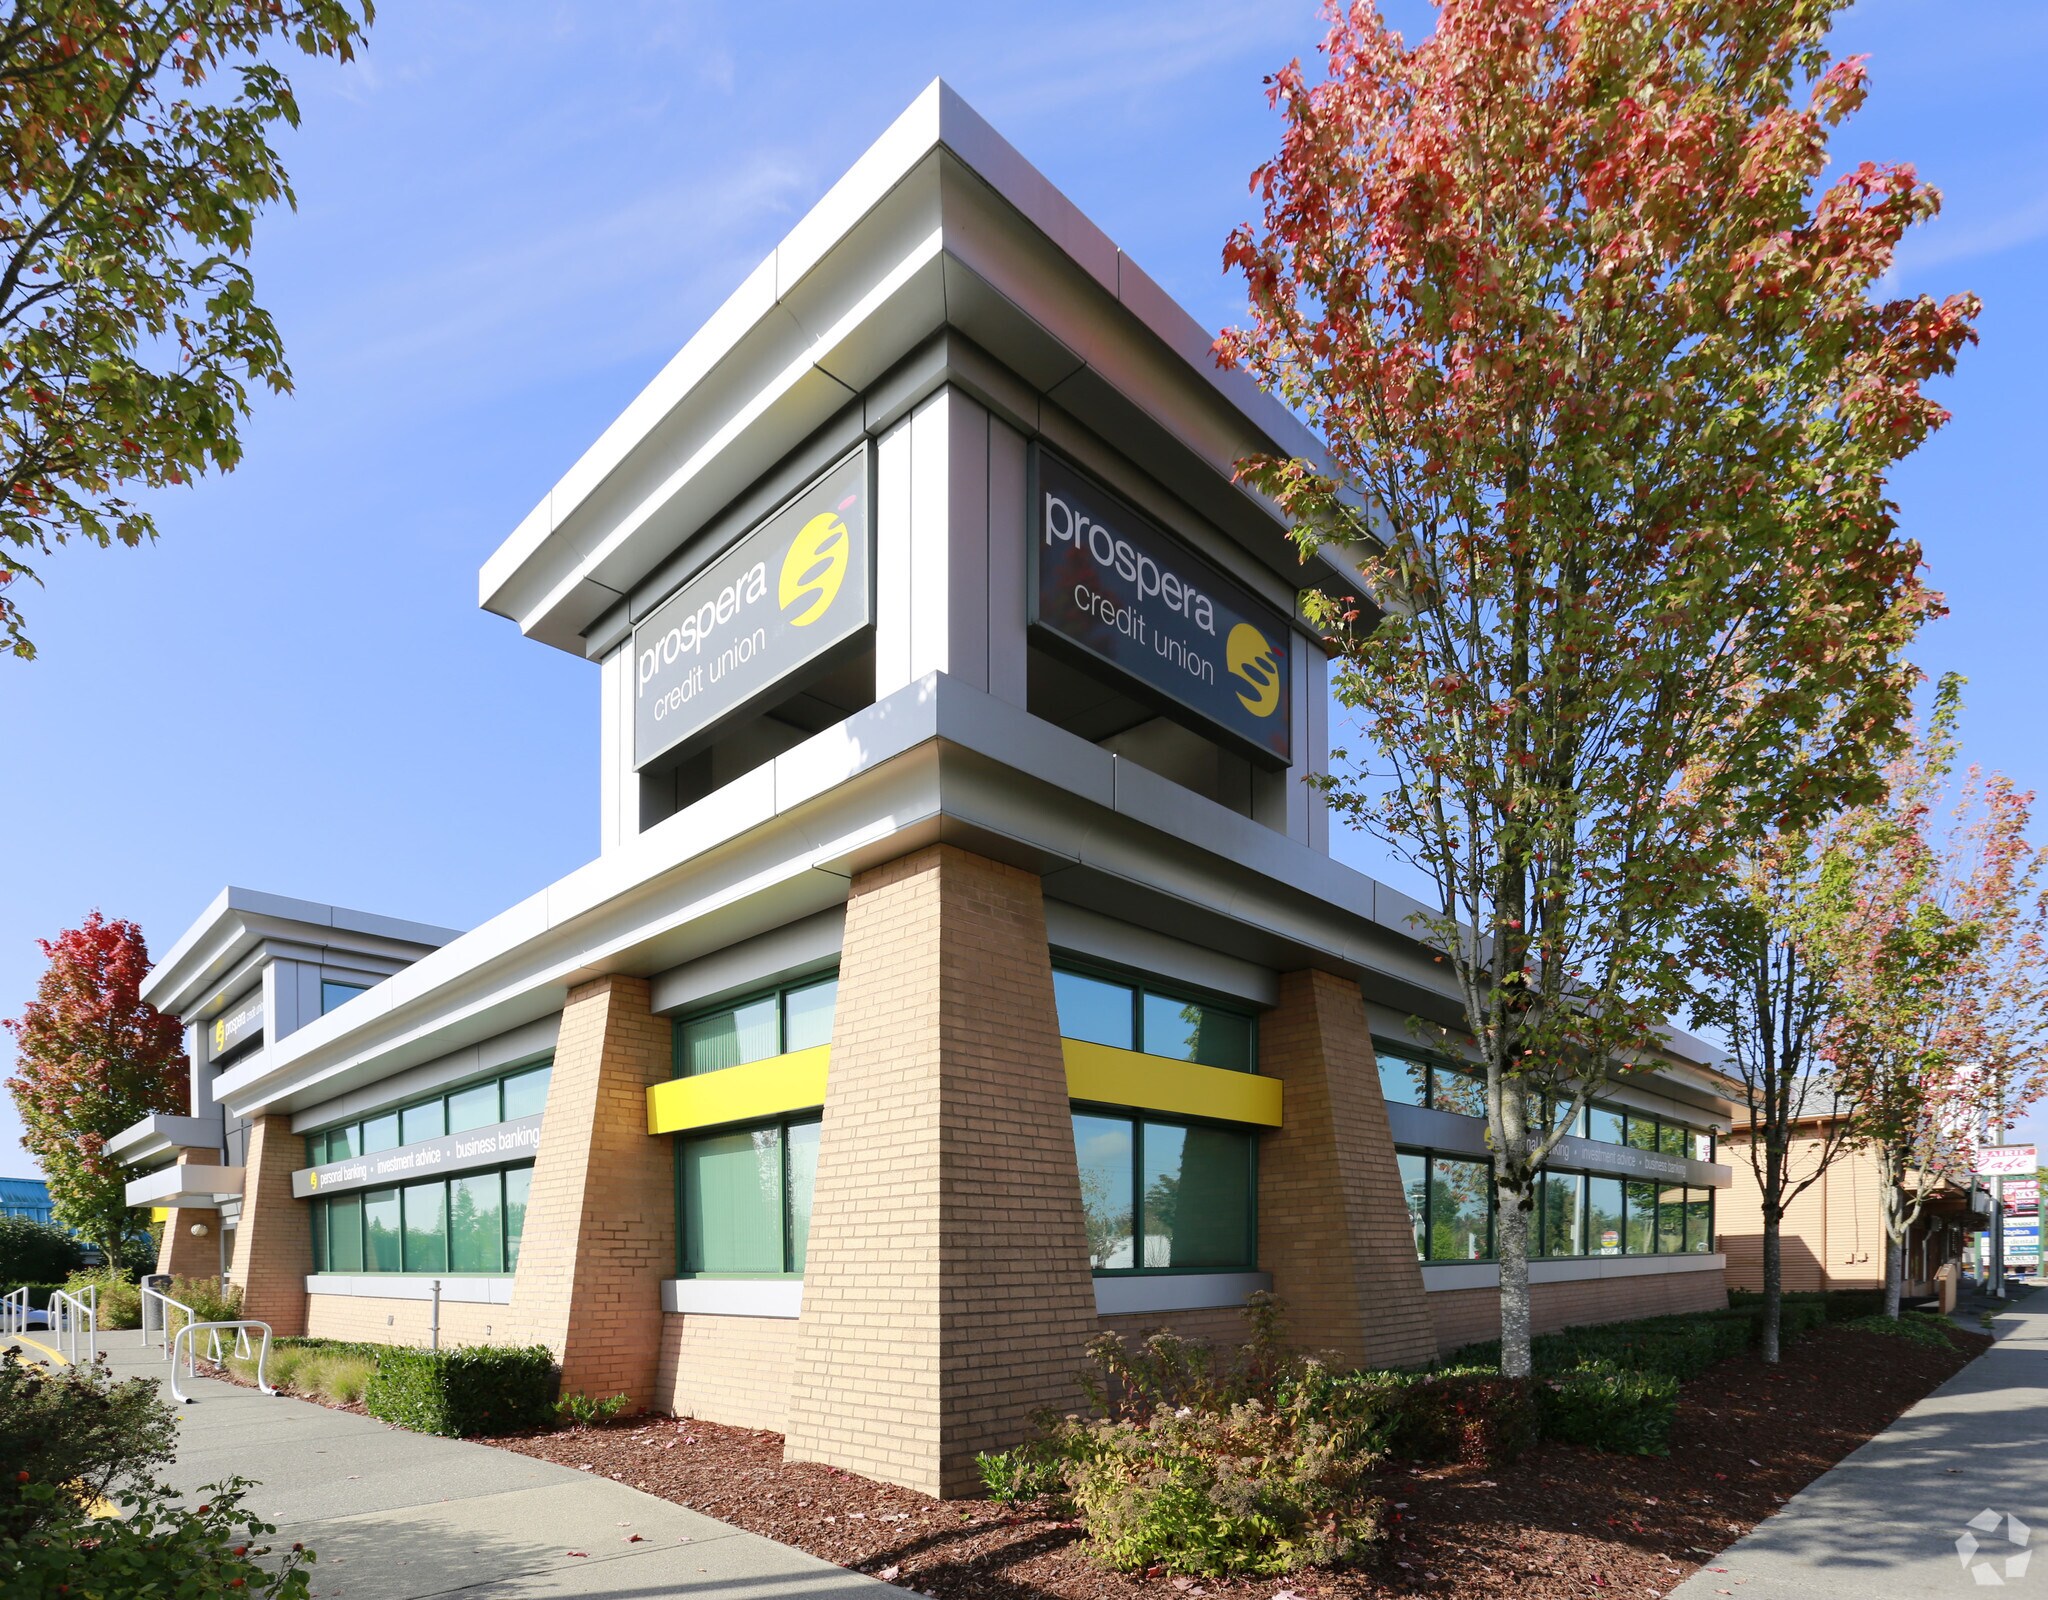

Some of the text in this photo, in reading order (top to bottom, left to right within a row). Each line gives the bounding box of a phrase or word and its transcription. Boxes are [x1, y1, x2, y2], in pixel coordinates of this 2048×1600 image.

[1045, 492, 1216, 636] prospera
[638, 561, 767, 698] prospera
[653, 627, 766, 721] credit union
[1074, 584, 1214, 685] credit union
[320, 1126, 541, 1188] personal banking investment advice business banking
[1581, 1144, 1616, 1164] investment
[1616, 1151, 1636, 1167] advice
[1644, 1155, 1668, 1173] business
[1667, 1160, 1687, 1178] banking
[1978, 1148, 2029, 1158] RAIRIE
